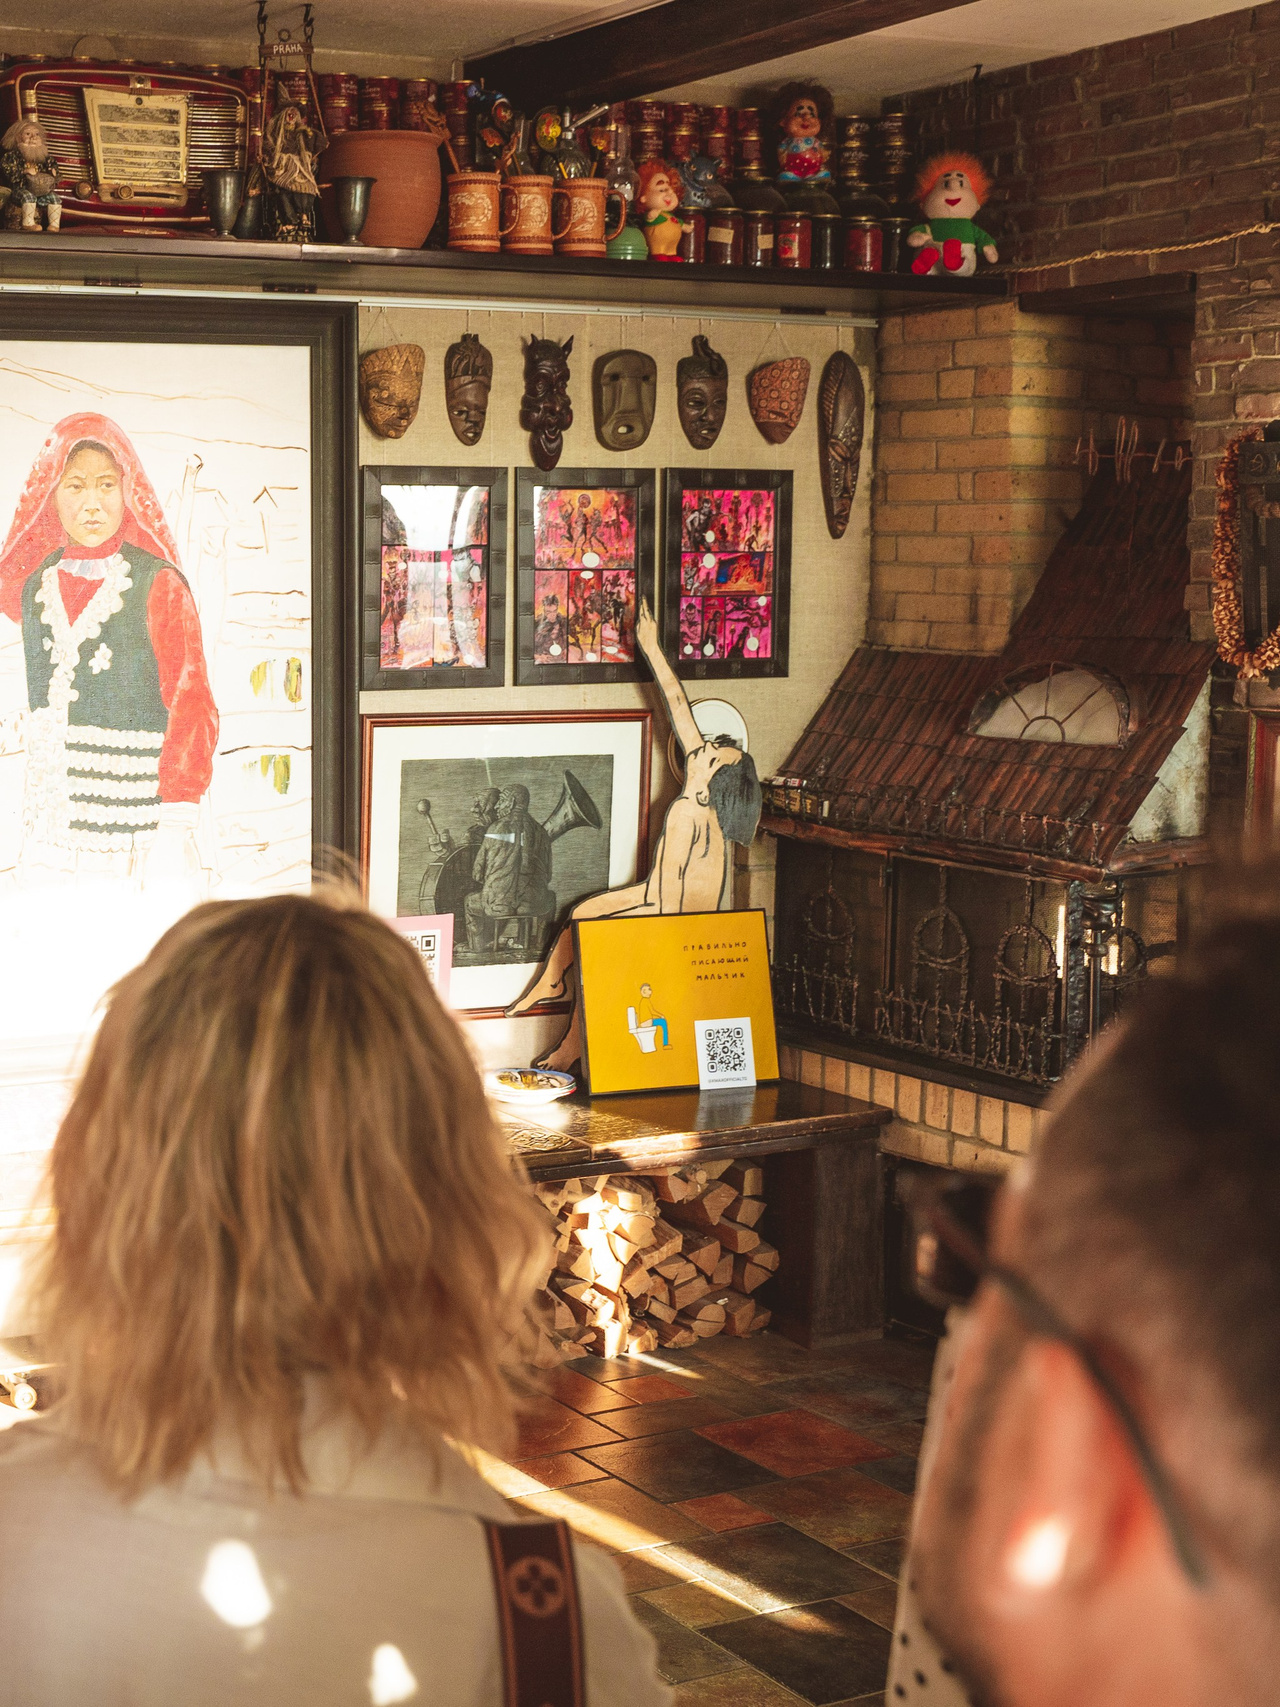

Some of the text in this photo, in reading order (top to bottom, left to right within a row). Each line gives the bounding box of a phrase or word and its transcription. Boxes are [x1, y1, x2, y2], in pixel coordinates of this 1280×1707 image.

[273, 43, 304, 54] PRAHA
[683, 941, 747, 952] ПРАВИЛЬНО
[691, 955, 749, 966] ПИСАЮЩИЙ
[696, 972, 746, 981] МАЛЬЧИК
